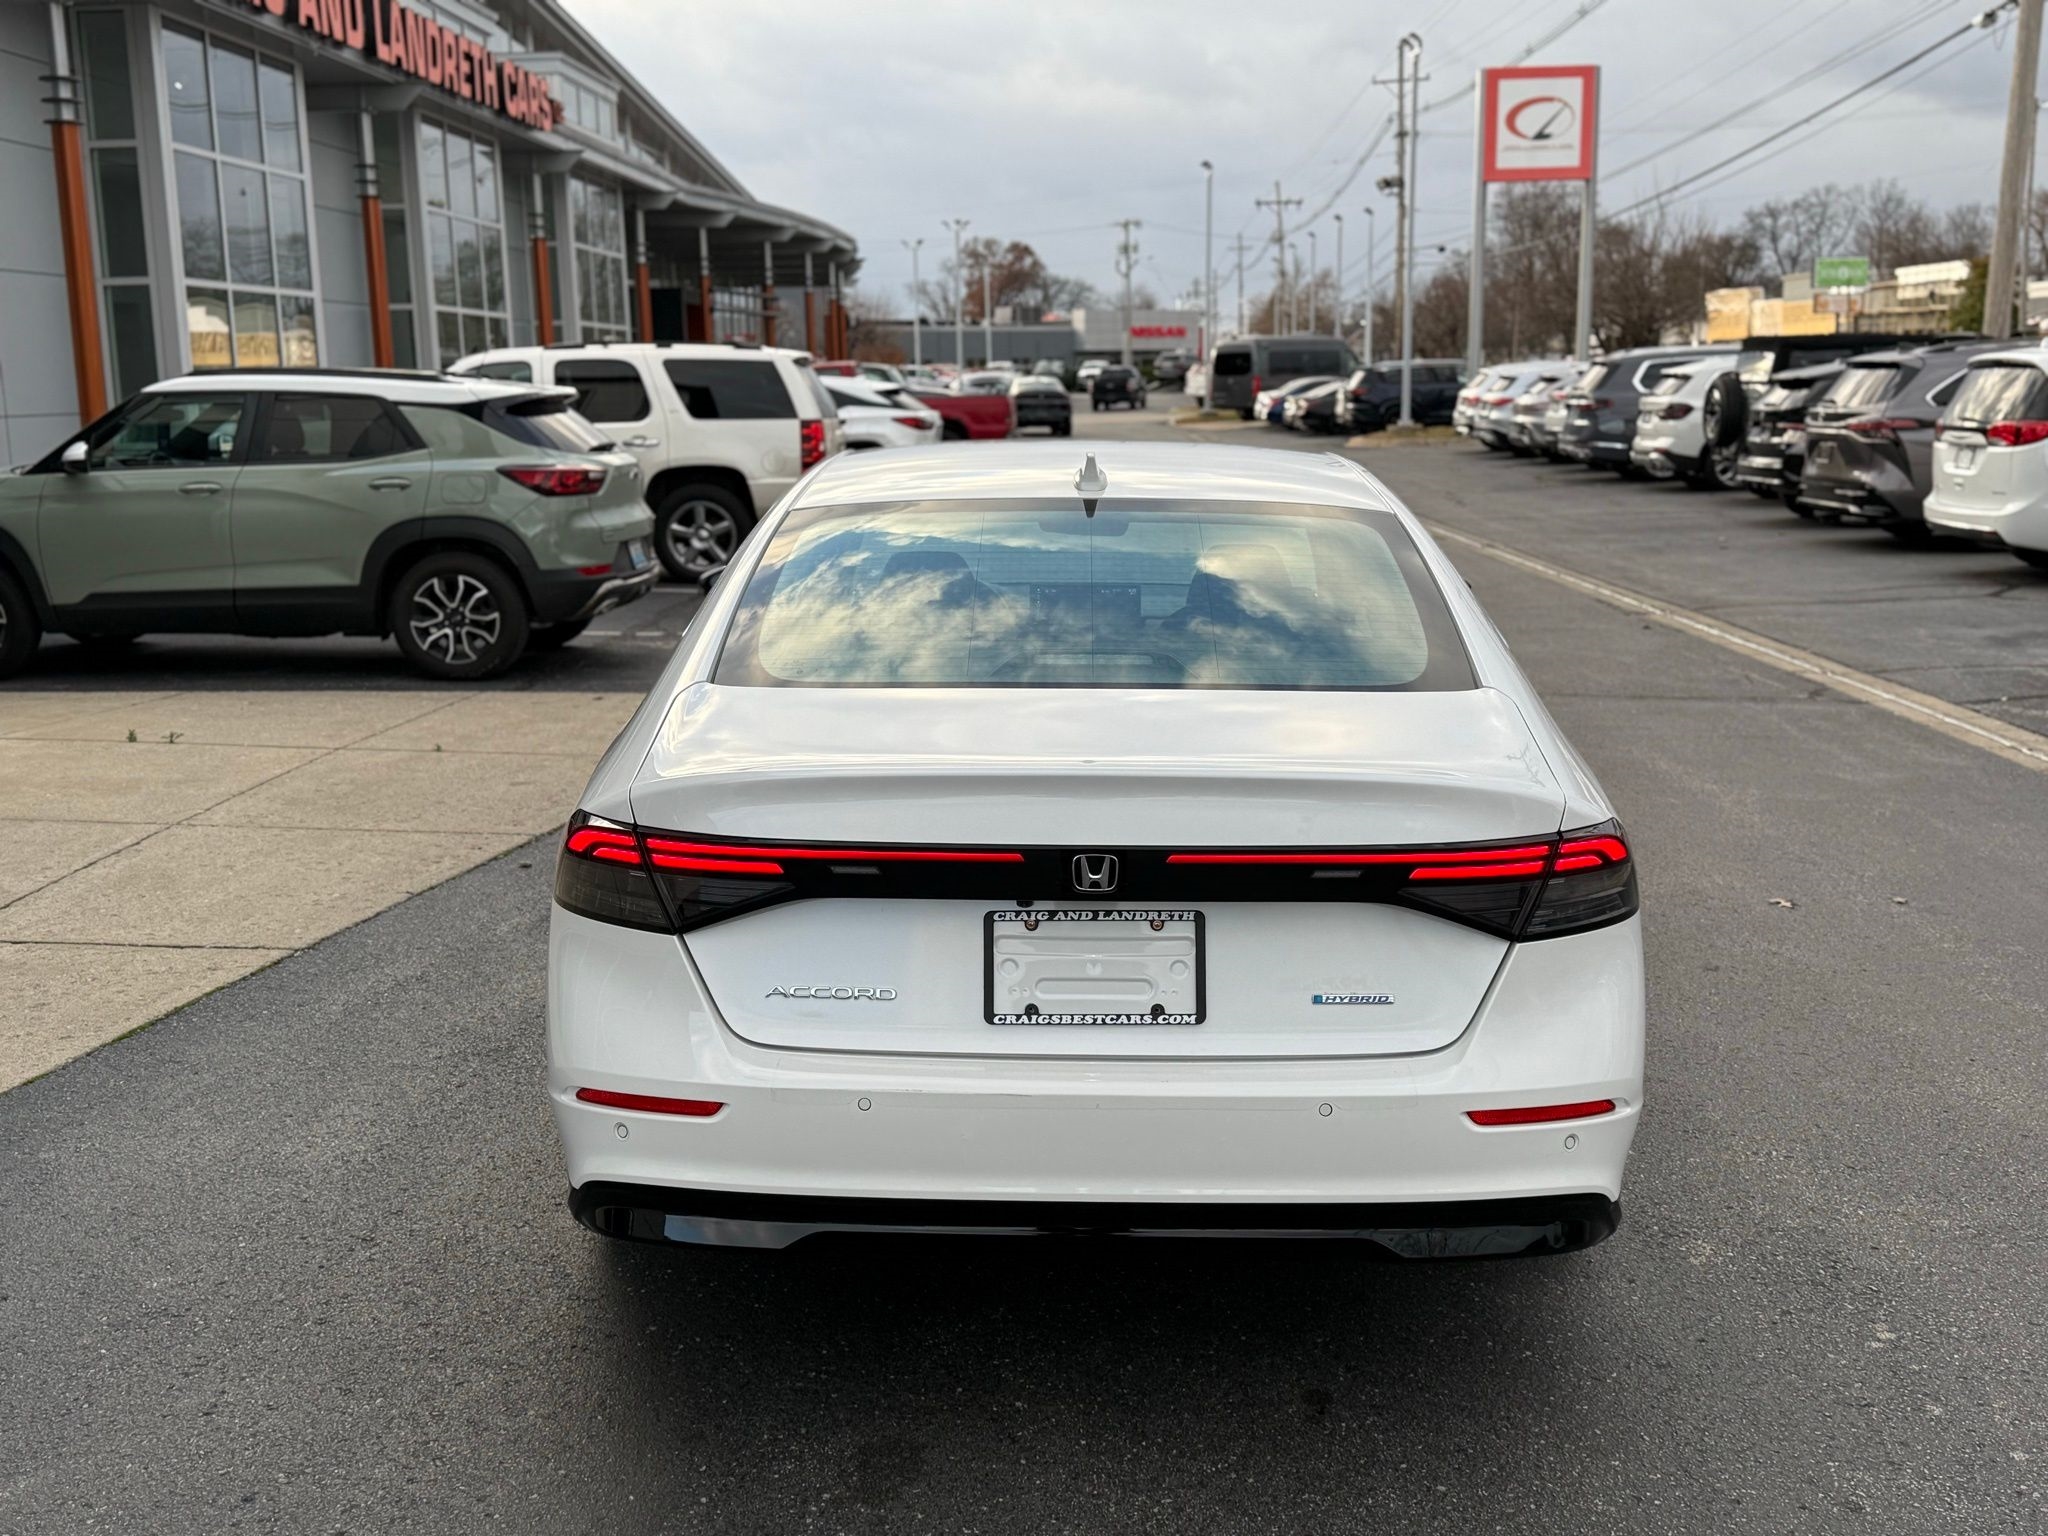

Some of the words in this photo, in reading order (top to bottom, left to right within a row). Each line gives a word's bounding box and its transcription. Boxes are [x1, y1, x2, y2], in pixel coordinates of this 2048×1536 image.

[373, 0, 500, 110] LANDRETH
[502, 59, 553, 132] CARS
[993, 911, 1050, 921] CRAIG
[1053, 911, 1093, 921] AND
[1097, 911, 1196, 921] LANDRETH
[765, 985, 897, 1001] ACCORD
[1324, 995, 1390, 1003] HYBRID
[993, 1014, 1197, 1025] CRAIGSBESTCARS.COM
